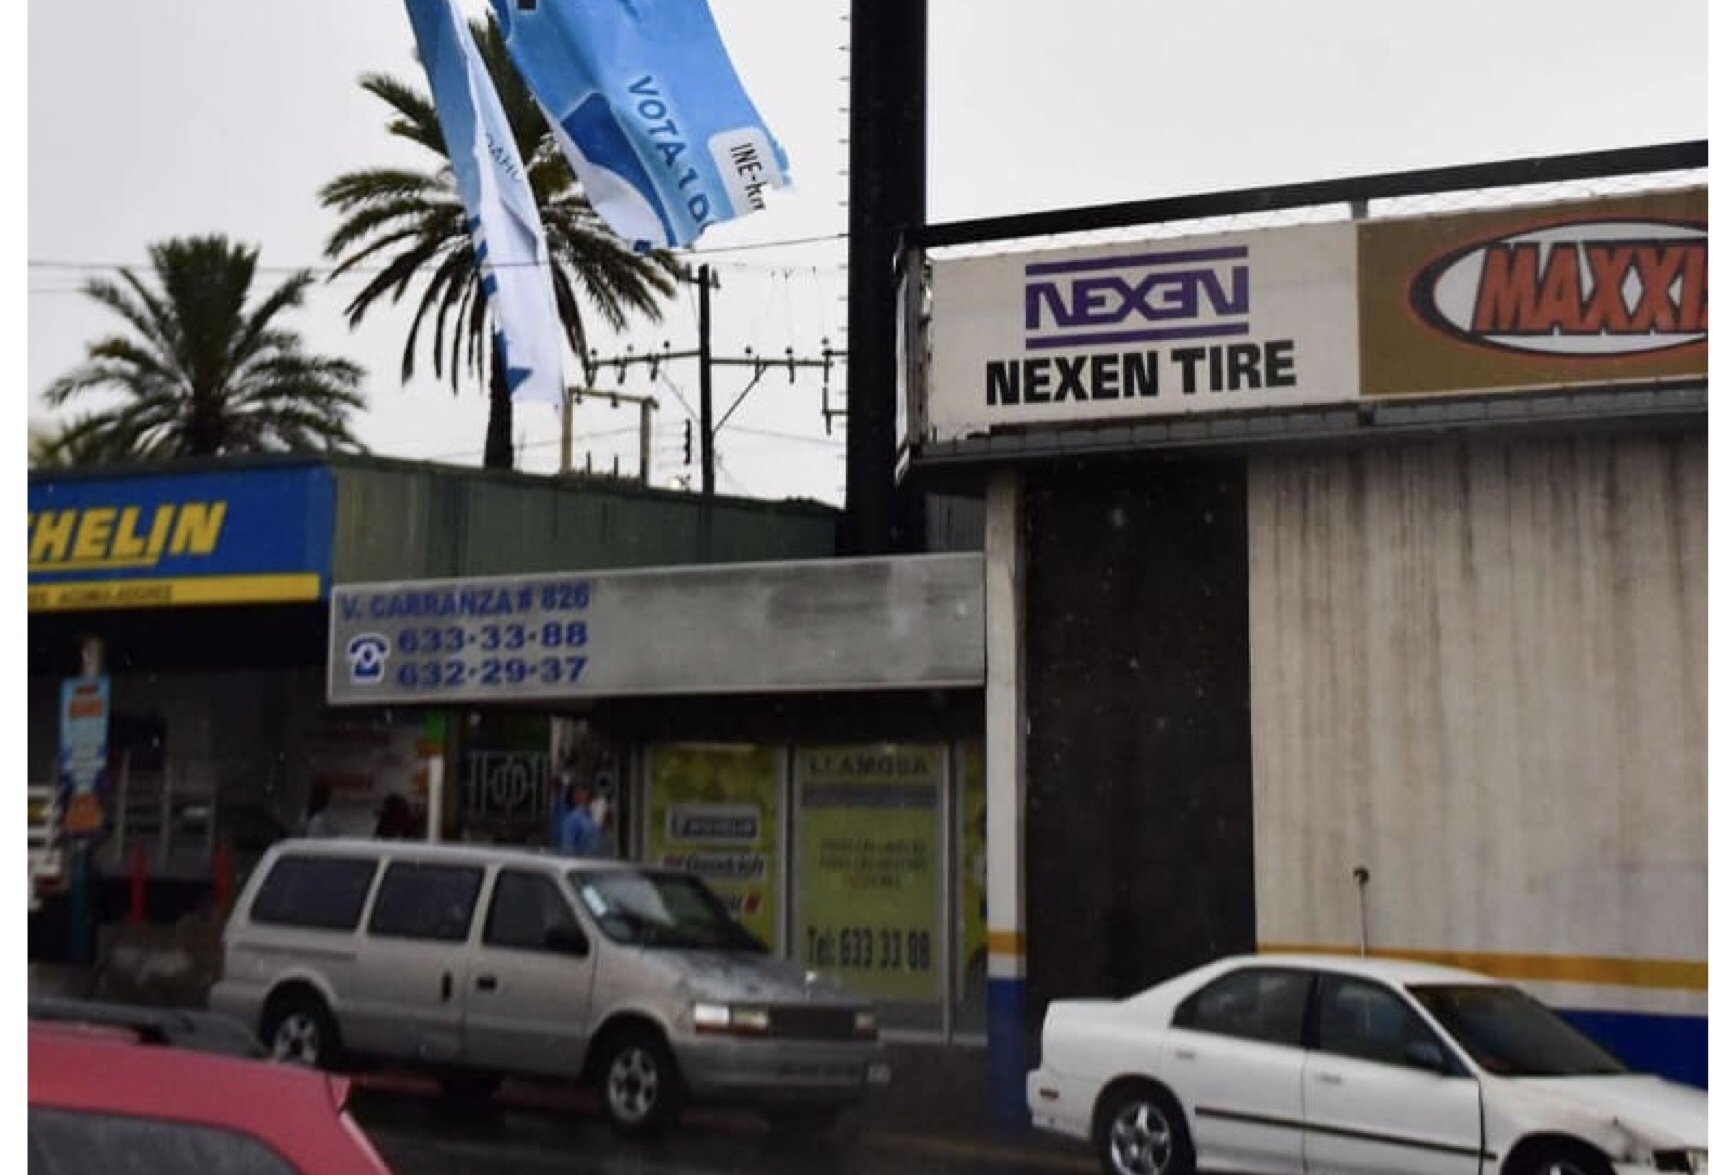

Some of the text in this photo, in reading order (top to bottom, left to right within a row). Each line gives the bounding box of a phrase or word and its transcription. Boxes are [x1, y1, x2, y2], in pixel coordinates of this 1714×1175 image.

[628, 74, 686, 168] VOTA
[678, 168, 699, 192] 1
[1025, 265, 1249, 330] NEXEN
[1472, 241, 1708, 334] MAXXI
[986, 339, 1297, 405] NEXEN TIRE
[28, 501, 227, 561] HELIN
[370, 590, 513, 618] CARRANZA
